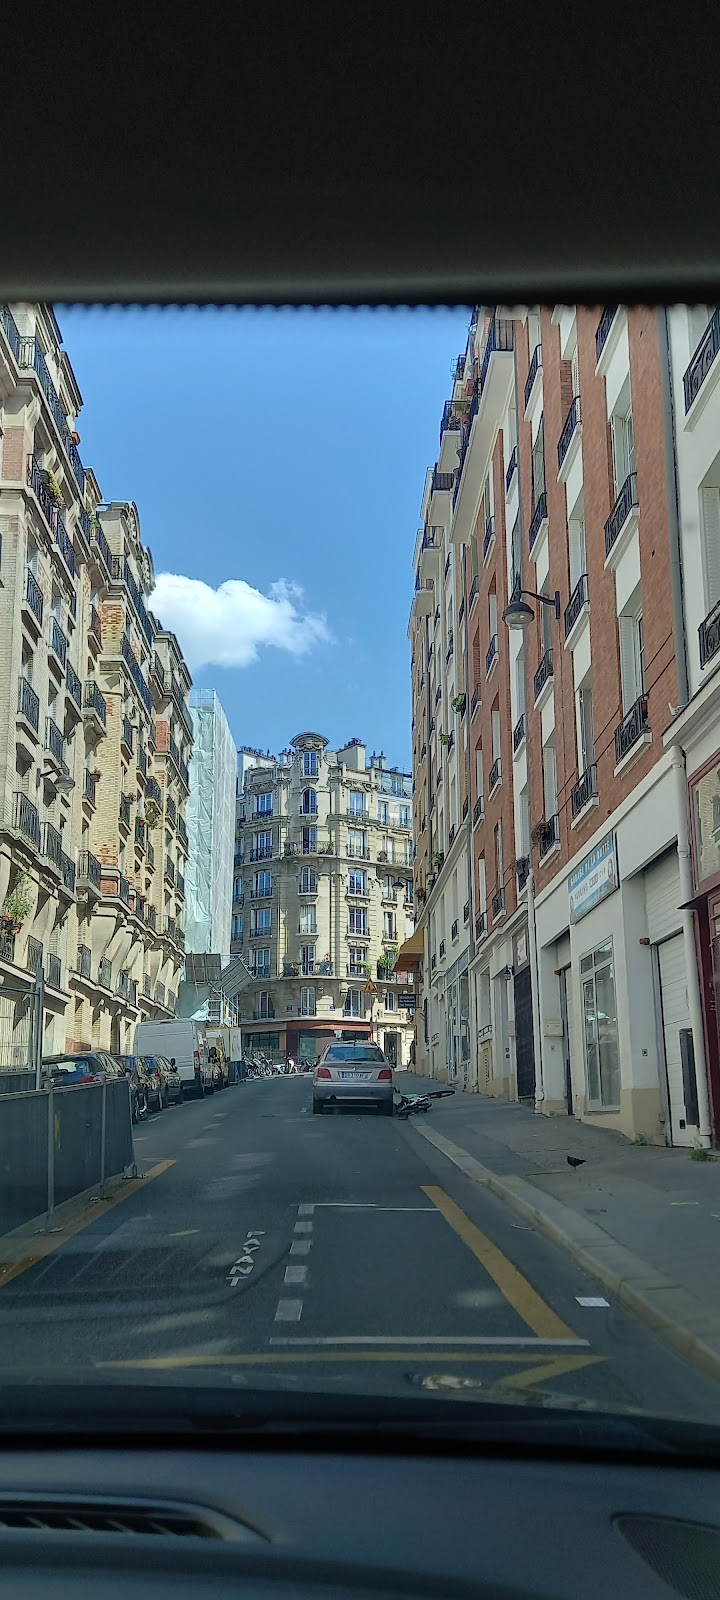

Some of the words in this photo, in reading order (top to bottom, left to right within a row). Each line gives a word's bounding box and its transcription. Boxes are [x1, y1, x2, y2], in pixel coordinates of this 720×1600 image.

[570, 866, 585, 887] GARAGE
[596, 840, 610, 860] BUTTE
[225, 1230, 266, 1287] PAYANT
